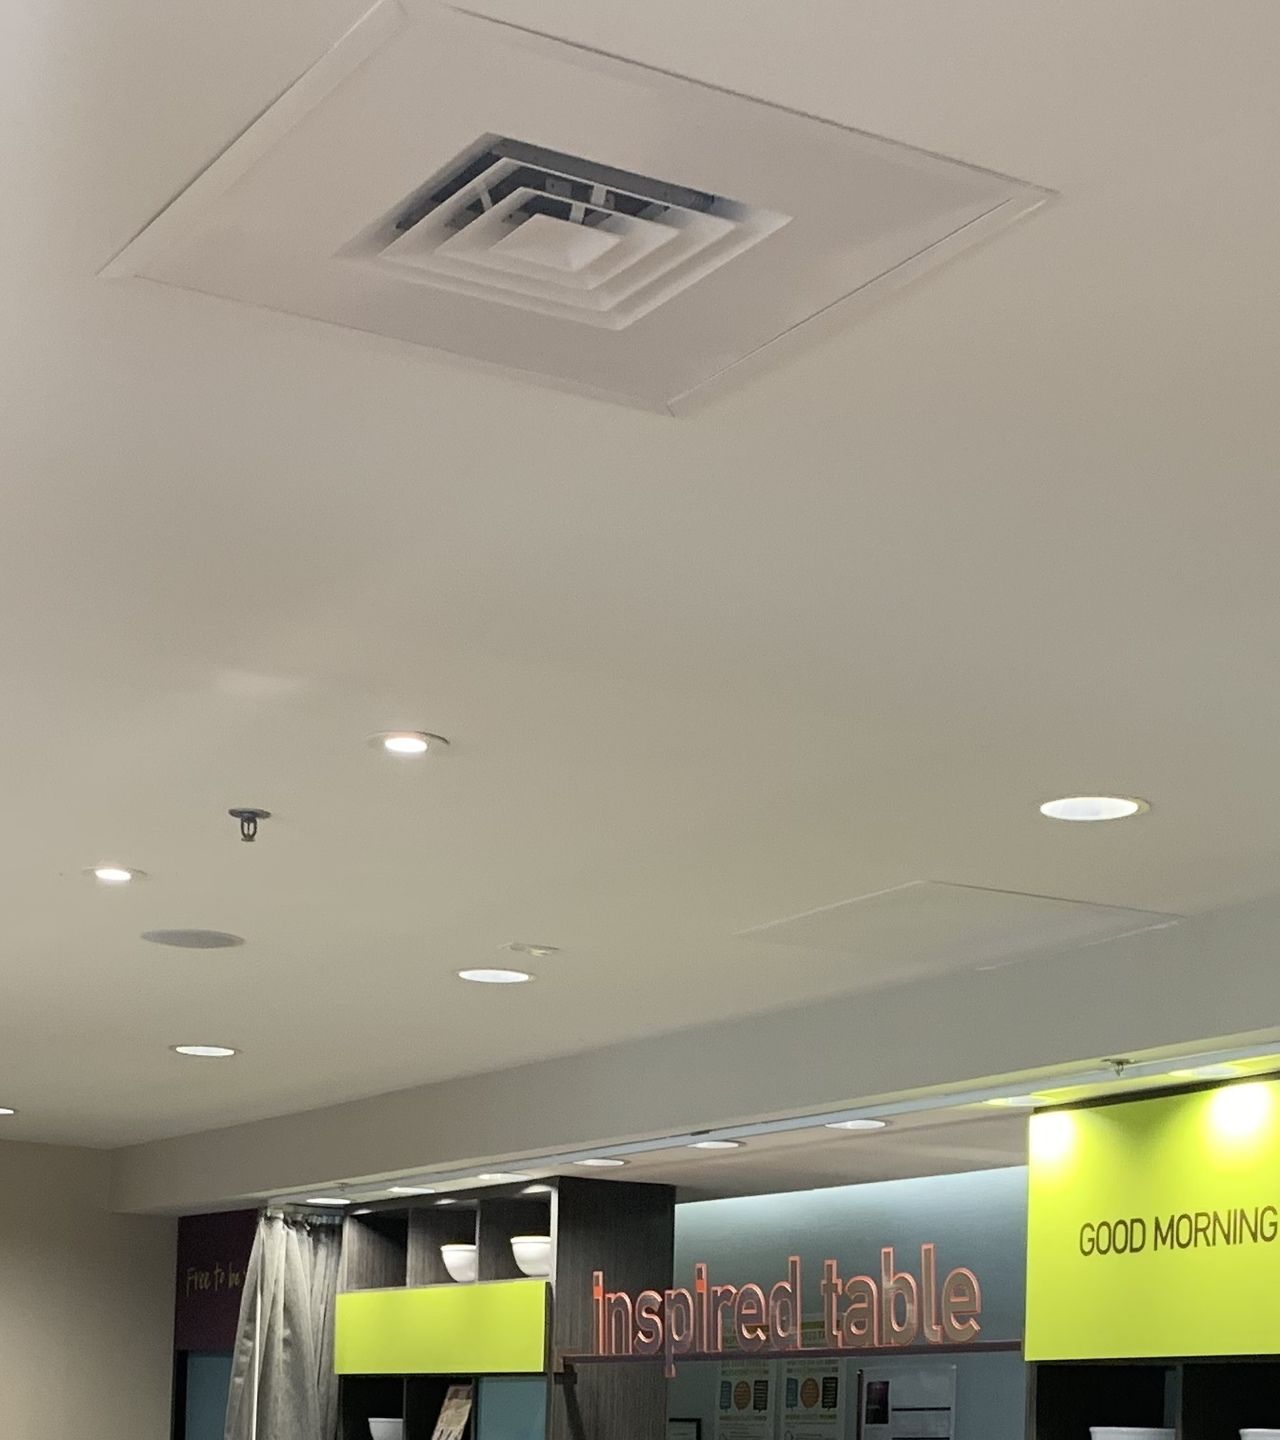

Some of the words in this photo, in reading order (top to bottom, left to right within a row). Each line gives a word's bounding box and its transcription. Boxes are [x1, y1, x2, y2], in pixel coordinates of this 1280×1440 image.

[1079, 1217, 1146, 1257] GOOD
[1153, 1205, 1278, 1251] MORNING
[820, 1243, 982, 1349] table
